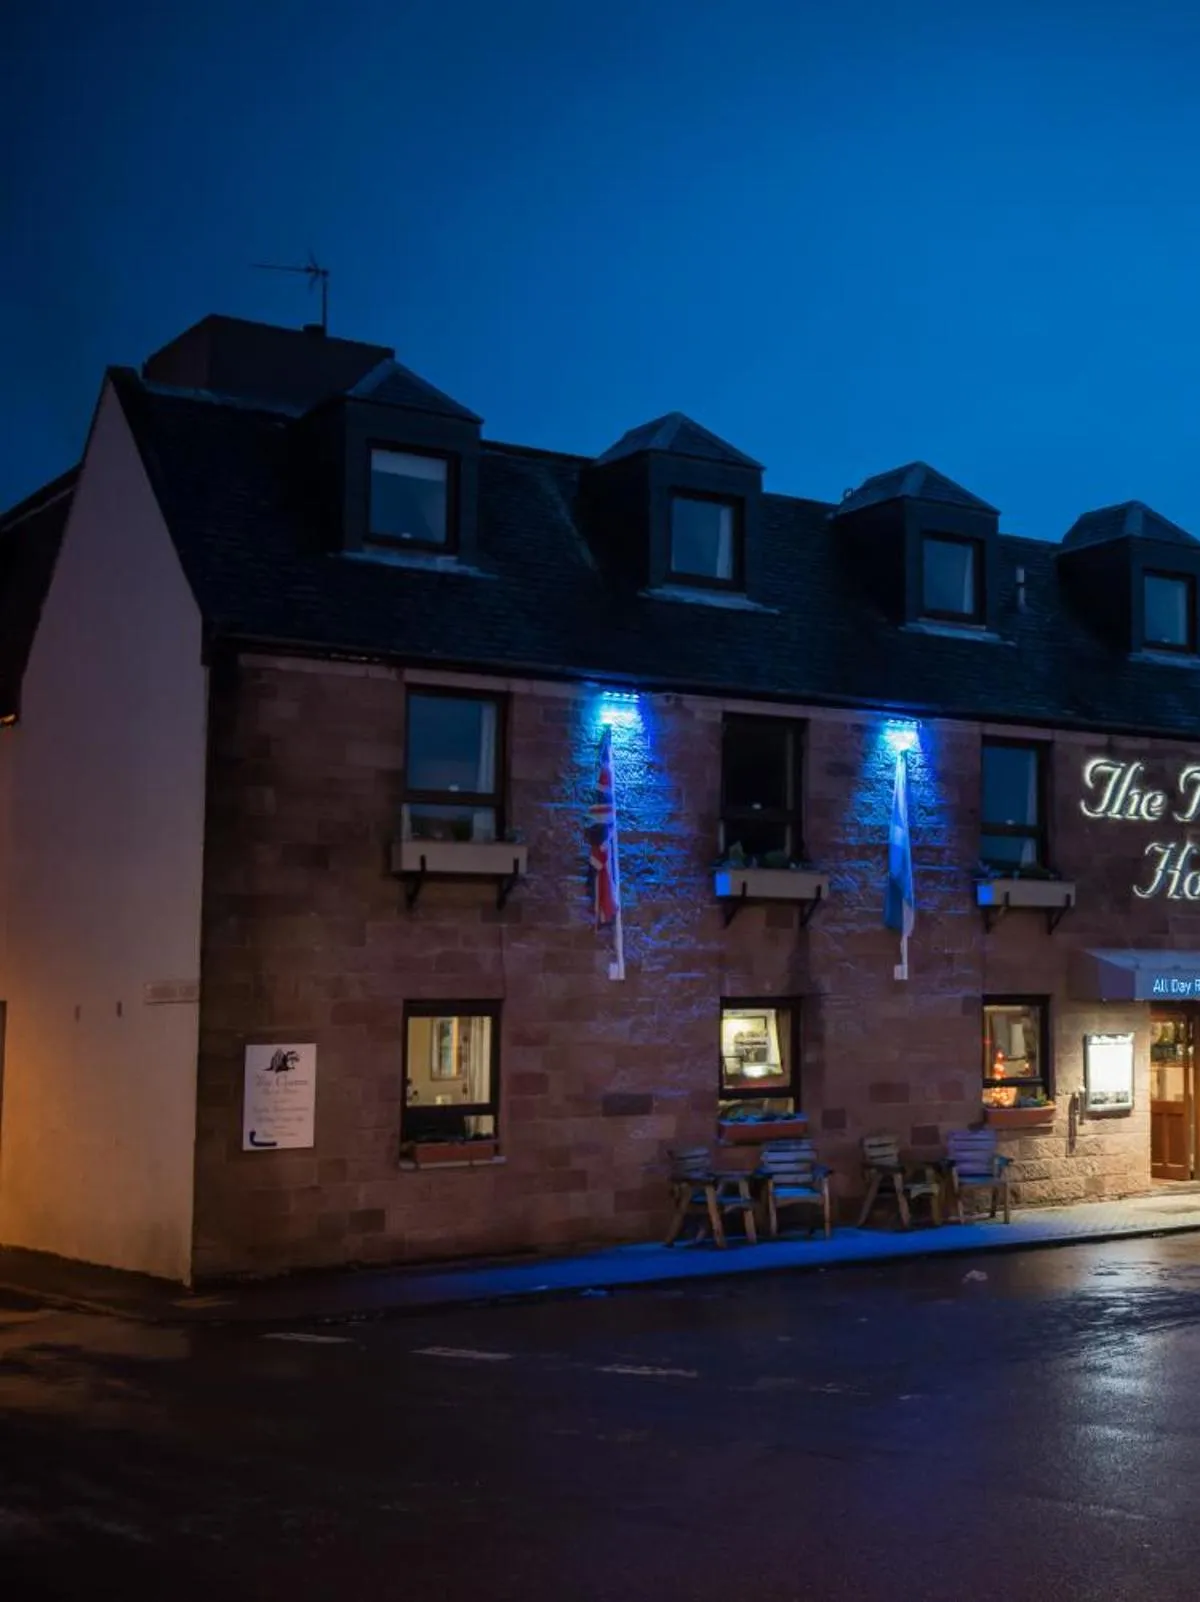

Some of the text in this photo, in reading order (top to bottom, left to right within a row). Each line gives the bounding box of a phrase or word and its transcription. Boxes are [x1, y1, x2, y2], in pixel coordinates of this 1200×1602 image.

[1080, 756, 1167, 821] The
[1152, 978, 1169, 993] All
[1170, 978, 1192, 996] Day
